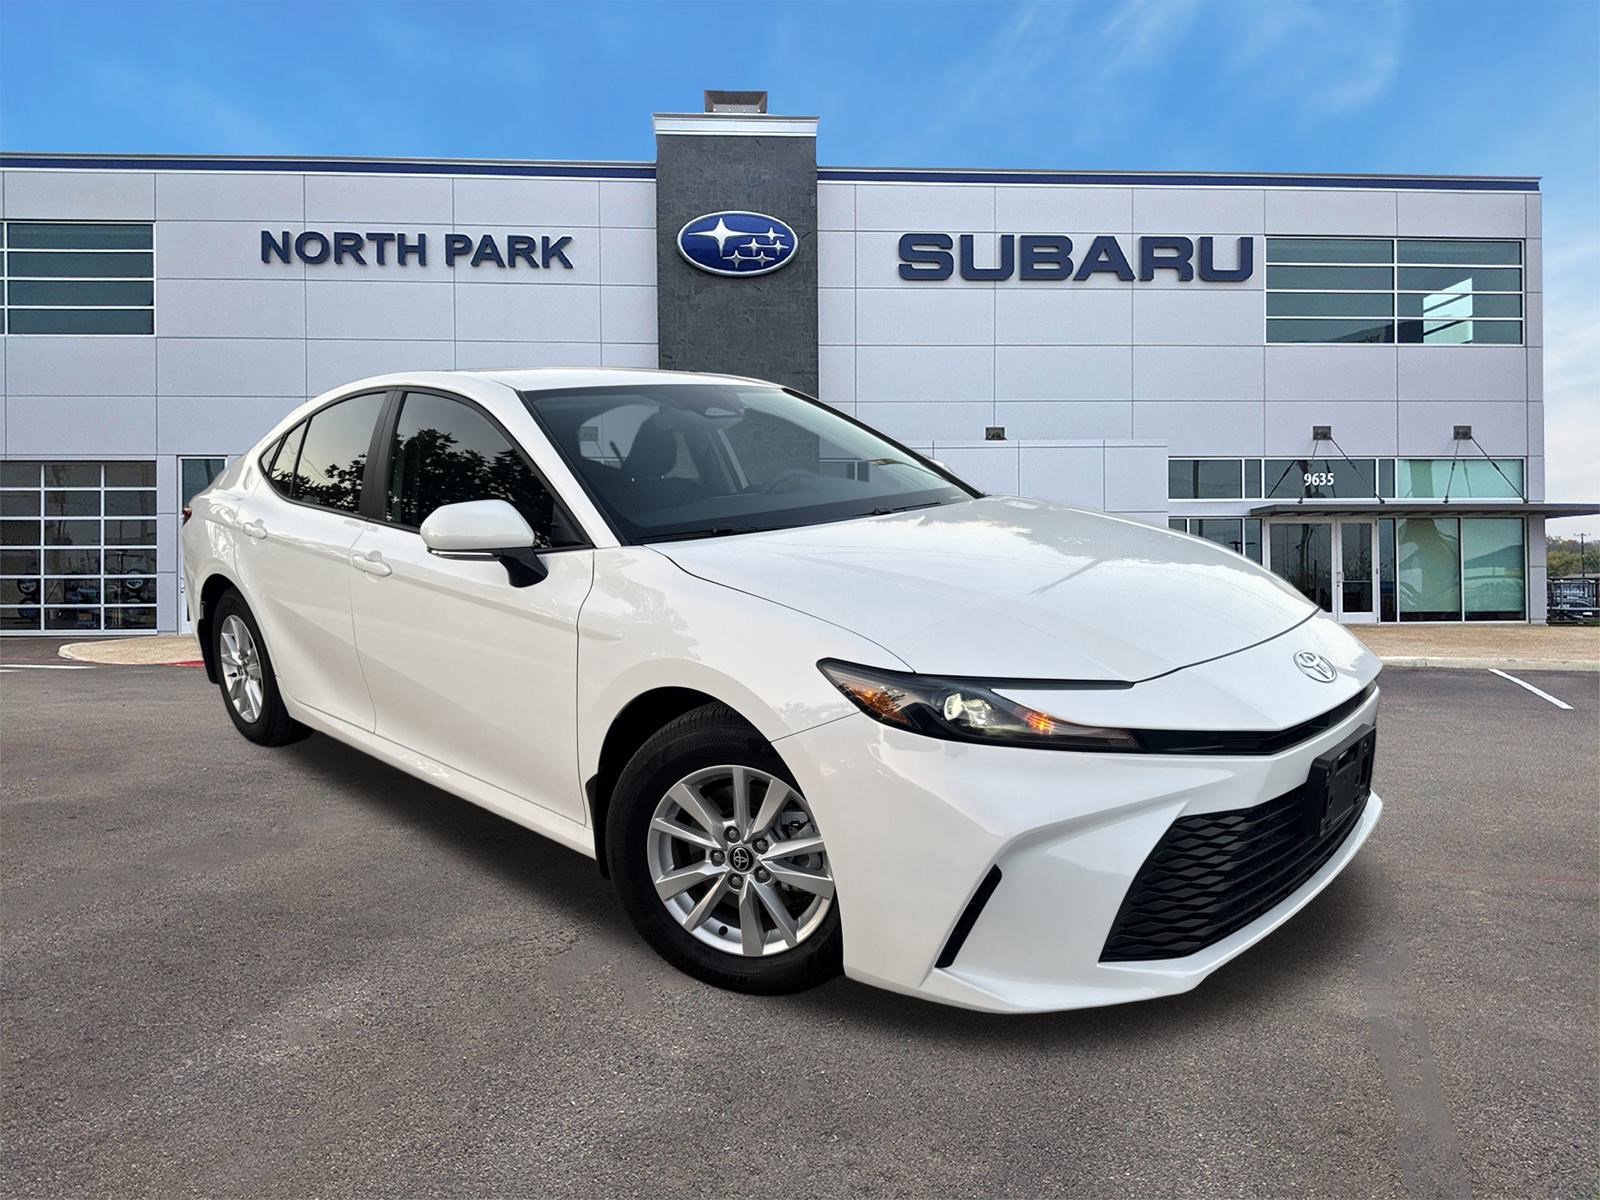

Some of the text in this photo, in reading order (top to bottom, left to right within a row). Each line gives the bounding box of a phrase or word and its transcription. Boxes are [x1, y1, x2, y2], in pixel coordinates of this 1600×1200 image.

[260, 230, 574, 269] NORTH PARK
[898, 233, 1254, 282] SUBARU
[1303, 472, 1335, 486] 9635
